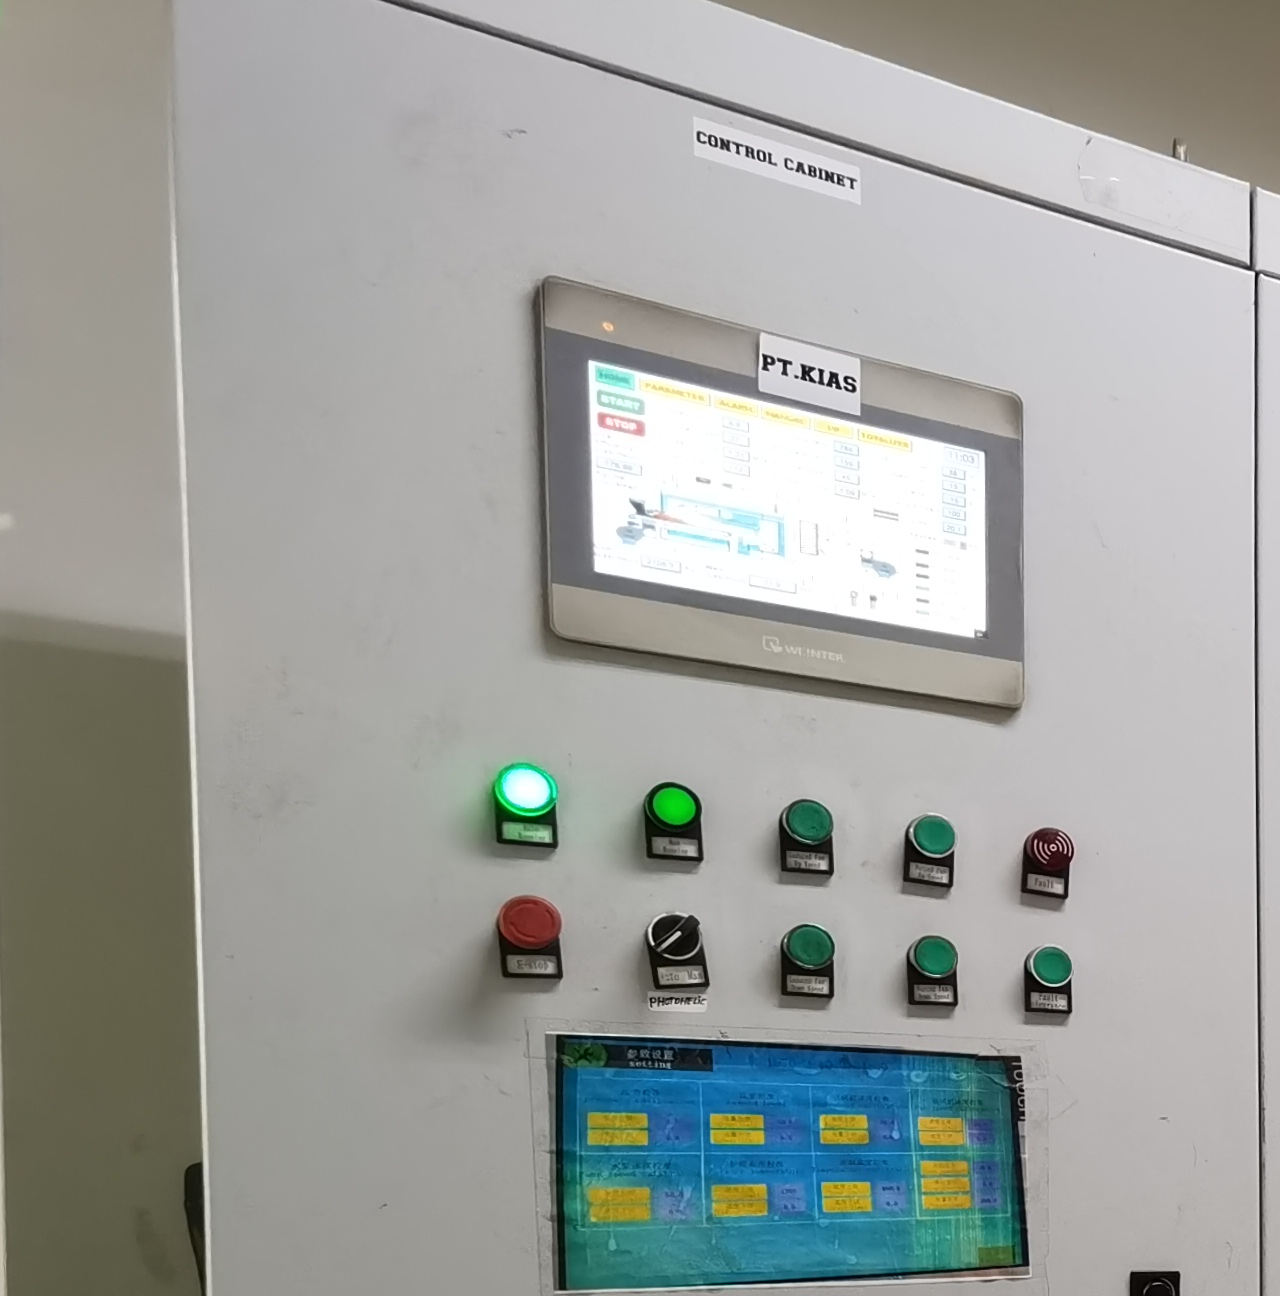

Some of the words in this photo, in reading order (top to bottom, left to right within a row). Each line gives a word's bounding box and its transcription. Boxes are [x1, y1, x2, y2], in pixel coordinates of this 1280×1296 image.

[696, 130, 778, 167] CONTROL
[784, 156, 858, 190] CABINET
[761, 352, 858, 394] PT.KIAS
[645, 381, 706, 402] PARAMETER
[600, 394, 641, 411] START
[605, 416, 637, 431] STOP
[949, 450, 975, 465] 11:03
[1034, 877, 1055, 888] Fault
[629, 1060, 673, 1070] setting
